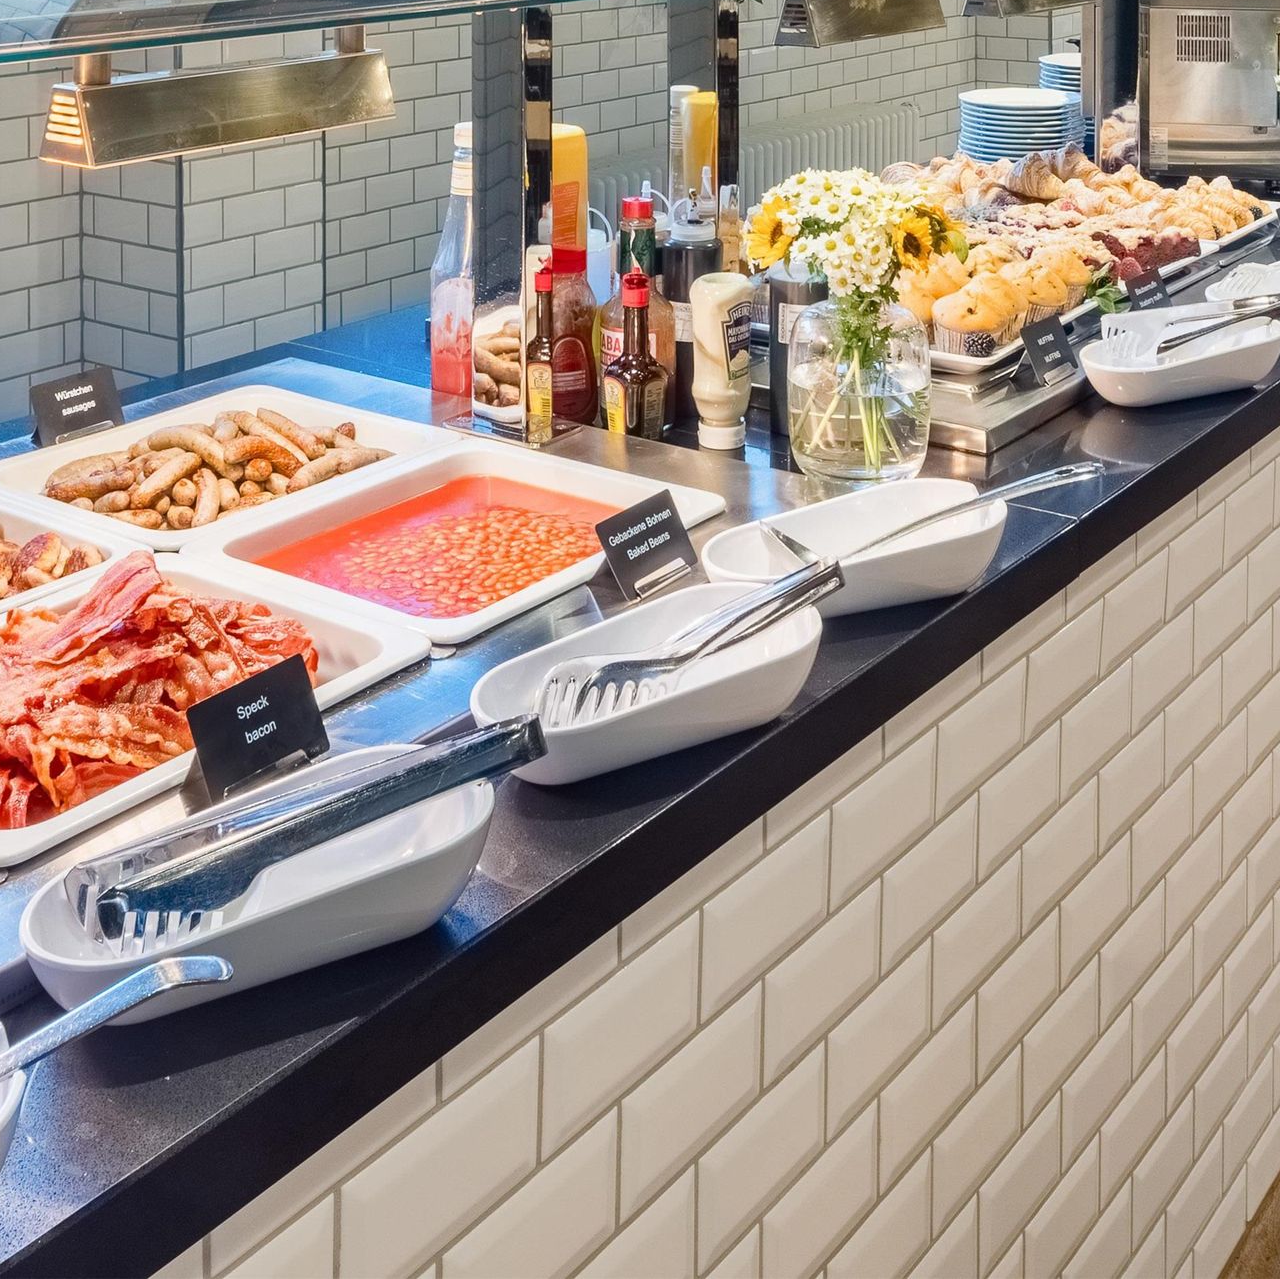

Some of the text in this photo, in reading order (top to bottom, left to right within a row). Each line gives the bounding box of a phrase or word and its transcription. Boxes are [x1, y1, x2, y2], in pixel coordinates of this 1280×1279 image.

[61, 400, 97, 416] sausages
[608, 508, 672, 547] Gebackene Bohnen
[626, 531, 671, 560] Baked Beans
[236, 695, 270, 720] Speck
[244, 720, 277, 744] bacon
